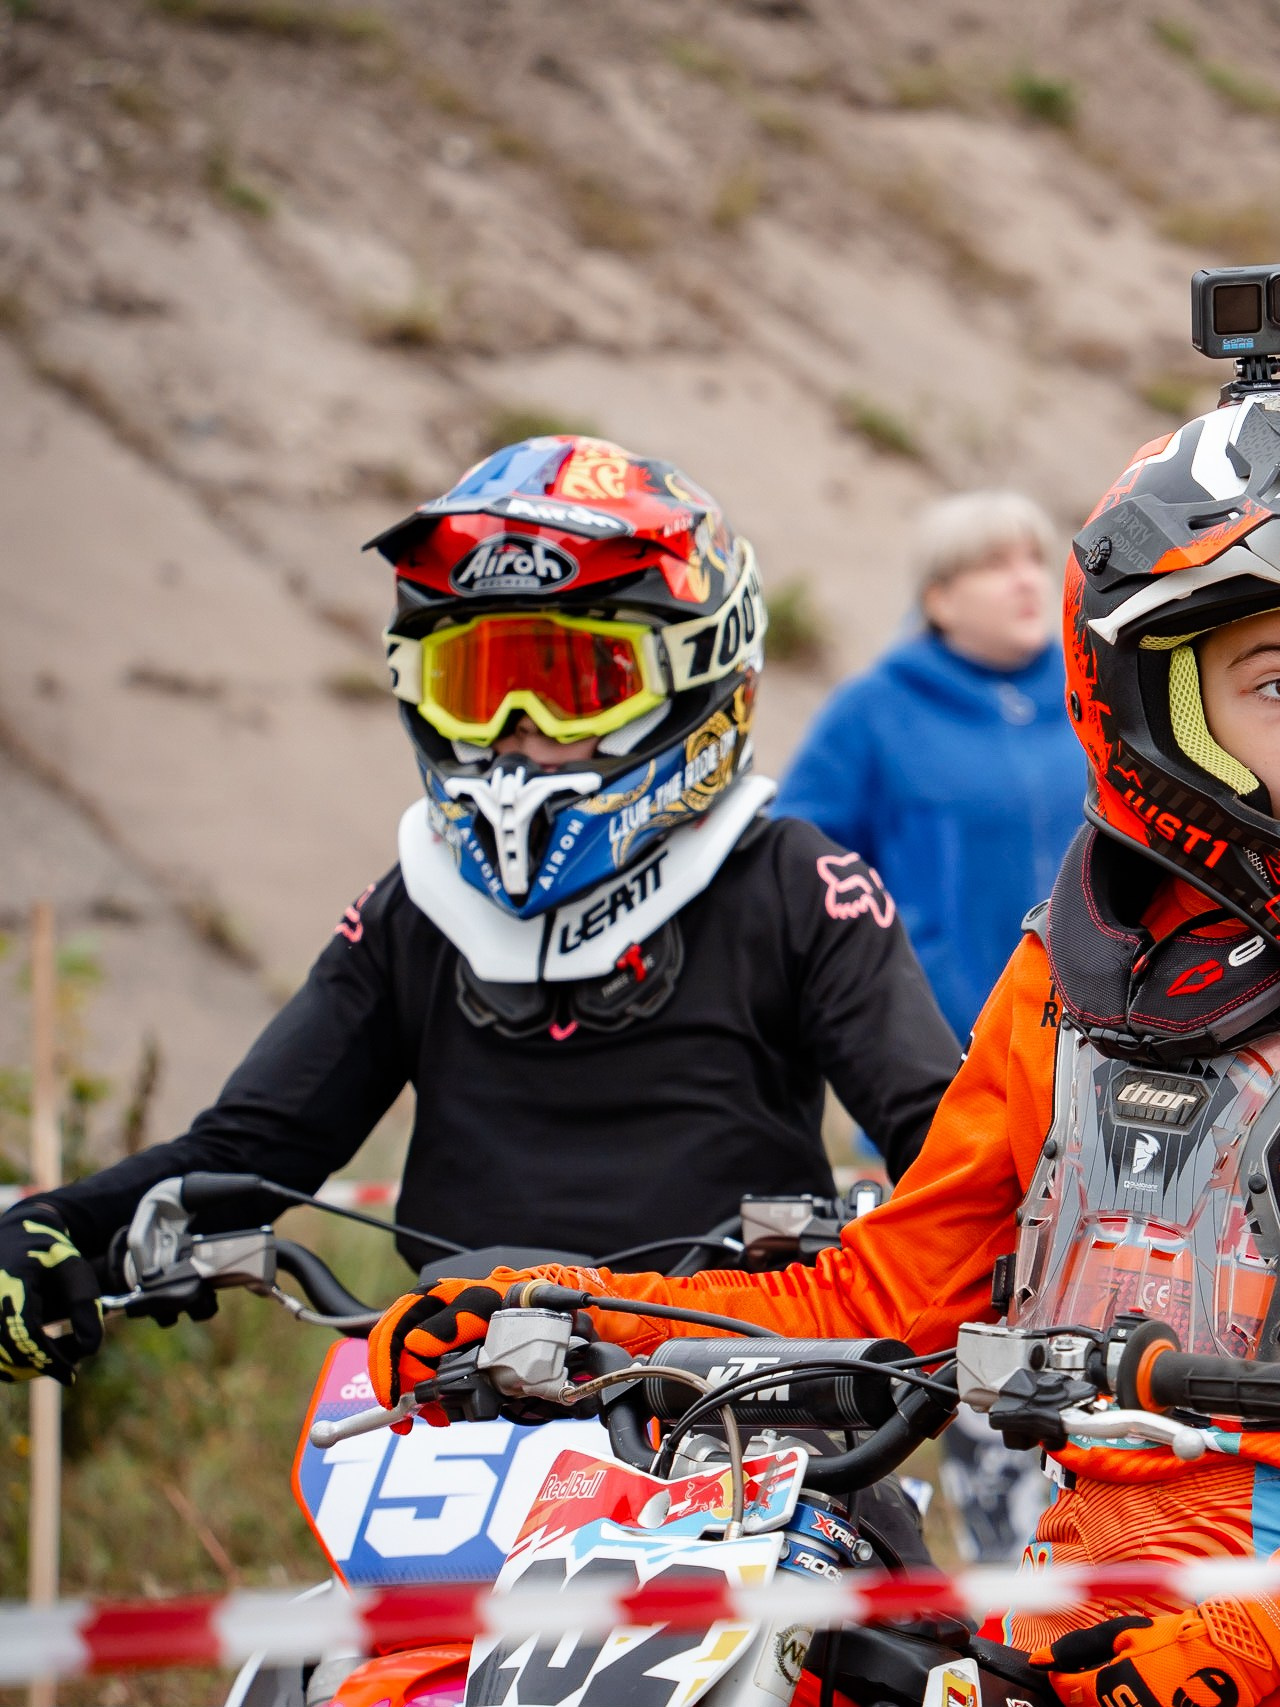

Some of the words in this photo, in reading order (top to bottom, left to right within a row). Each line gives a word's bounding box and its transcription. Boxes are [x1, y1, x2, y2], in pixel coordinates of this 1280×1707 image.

[1222, 337, 1254, 345] GoPro
[457, 543, 563, 584] Airoh
[538, 818, 584, 891] AIROH
[559, 850, 668, 954] LEATT
[1117, 1081, 1198, 1111] thor
[539, 1473, 569, 1501] Red
[568, 1470, 607, 1499] Bull
[811, 1511, 856, 1548] XTRIG
